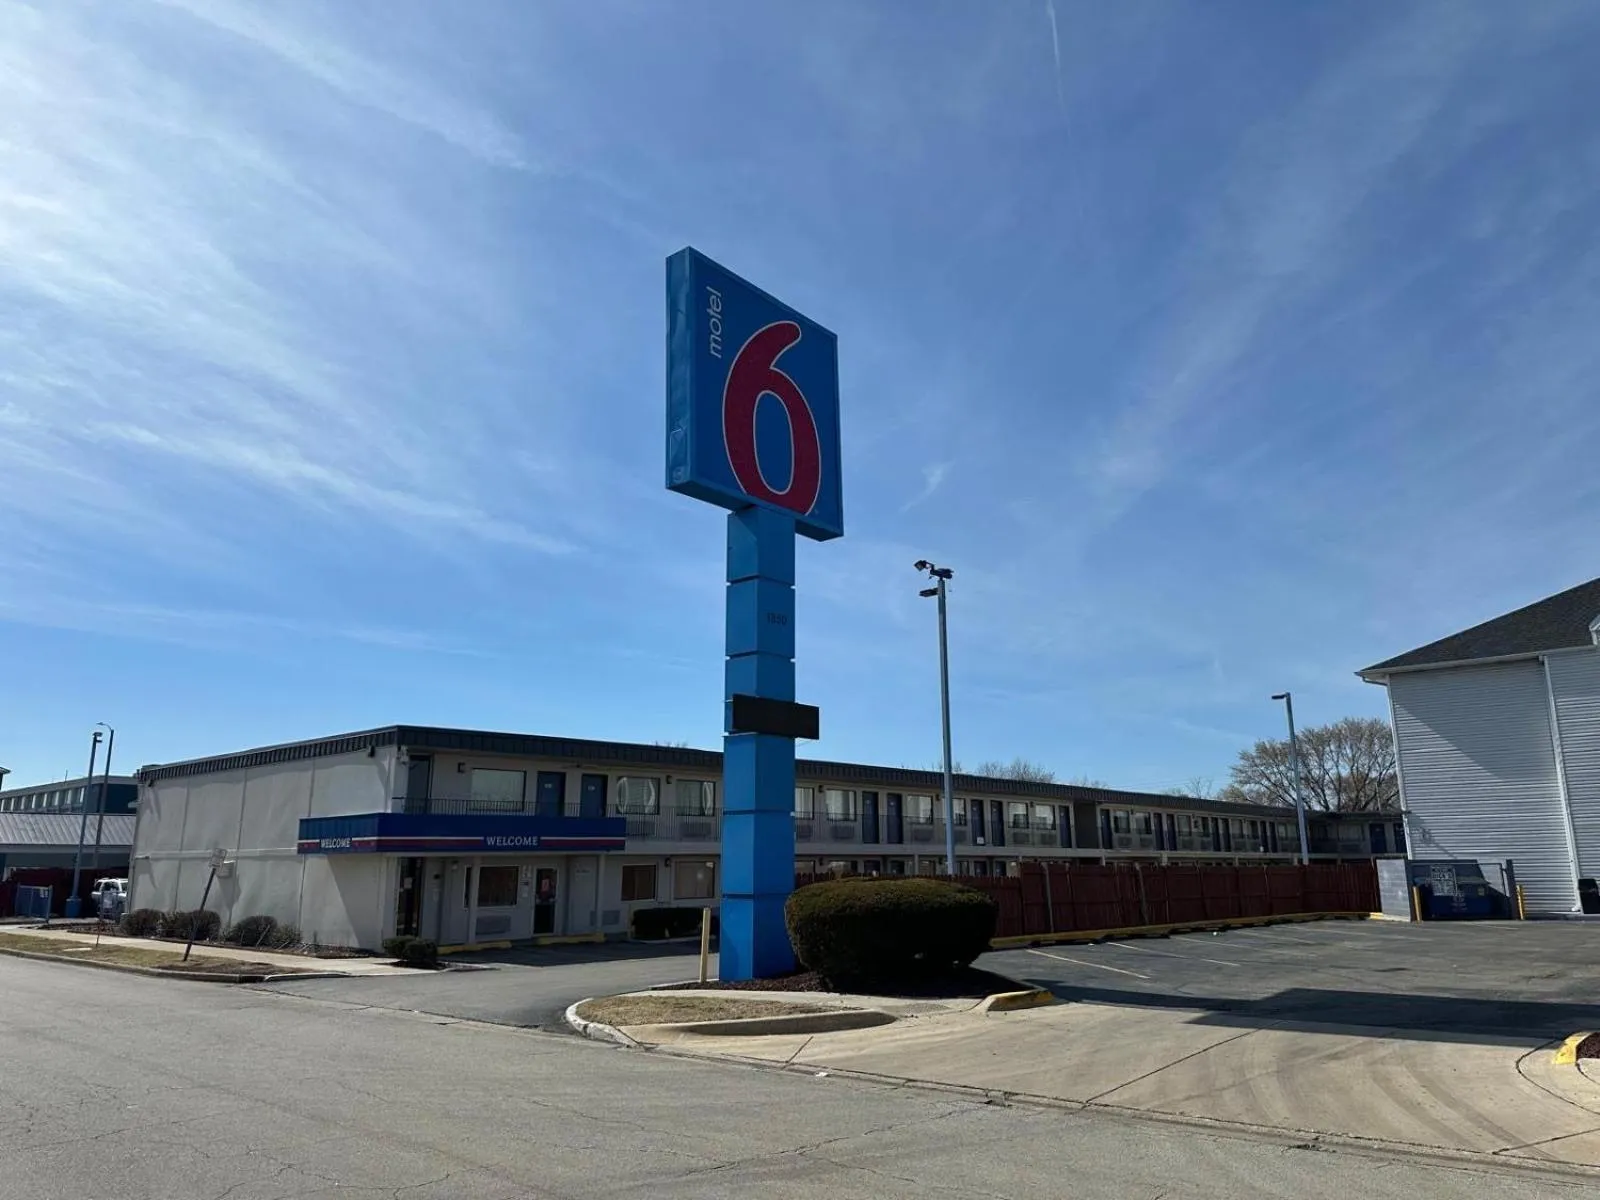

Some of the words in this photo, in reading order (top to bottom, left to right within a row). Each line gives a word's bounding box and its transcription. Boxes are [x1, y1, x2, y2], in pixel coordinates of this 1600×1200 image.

[706, 286, 722, 358] motel
[722, 321, 821, 516] 6
[320, 838, 351, 848] WELCOME
[486, 836, 538, 846] WELCOME
